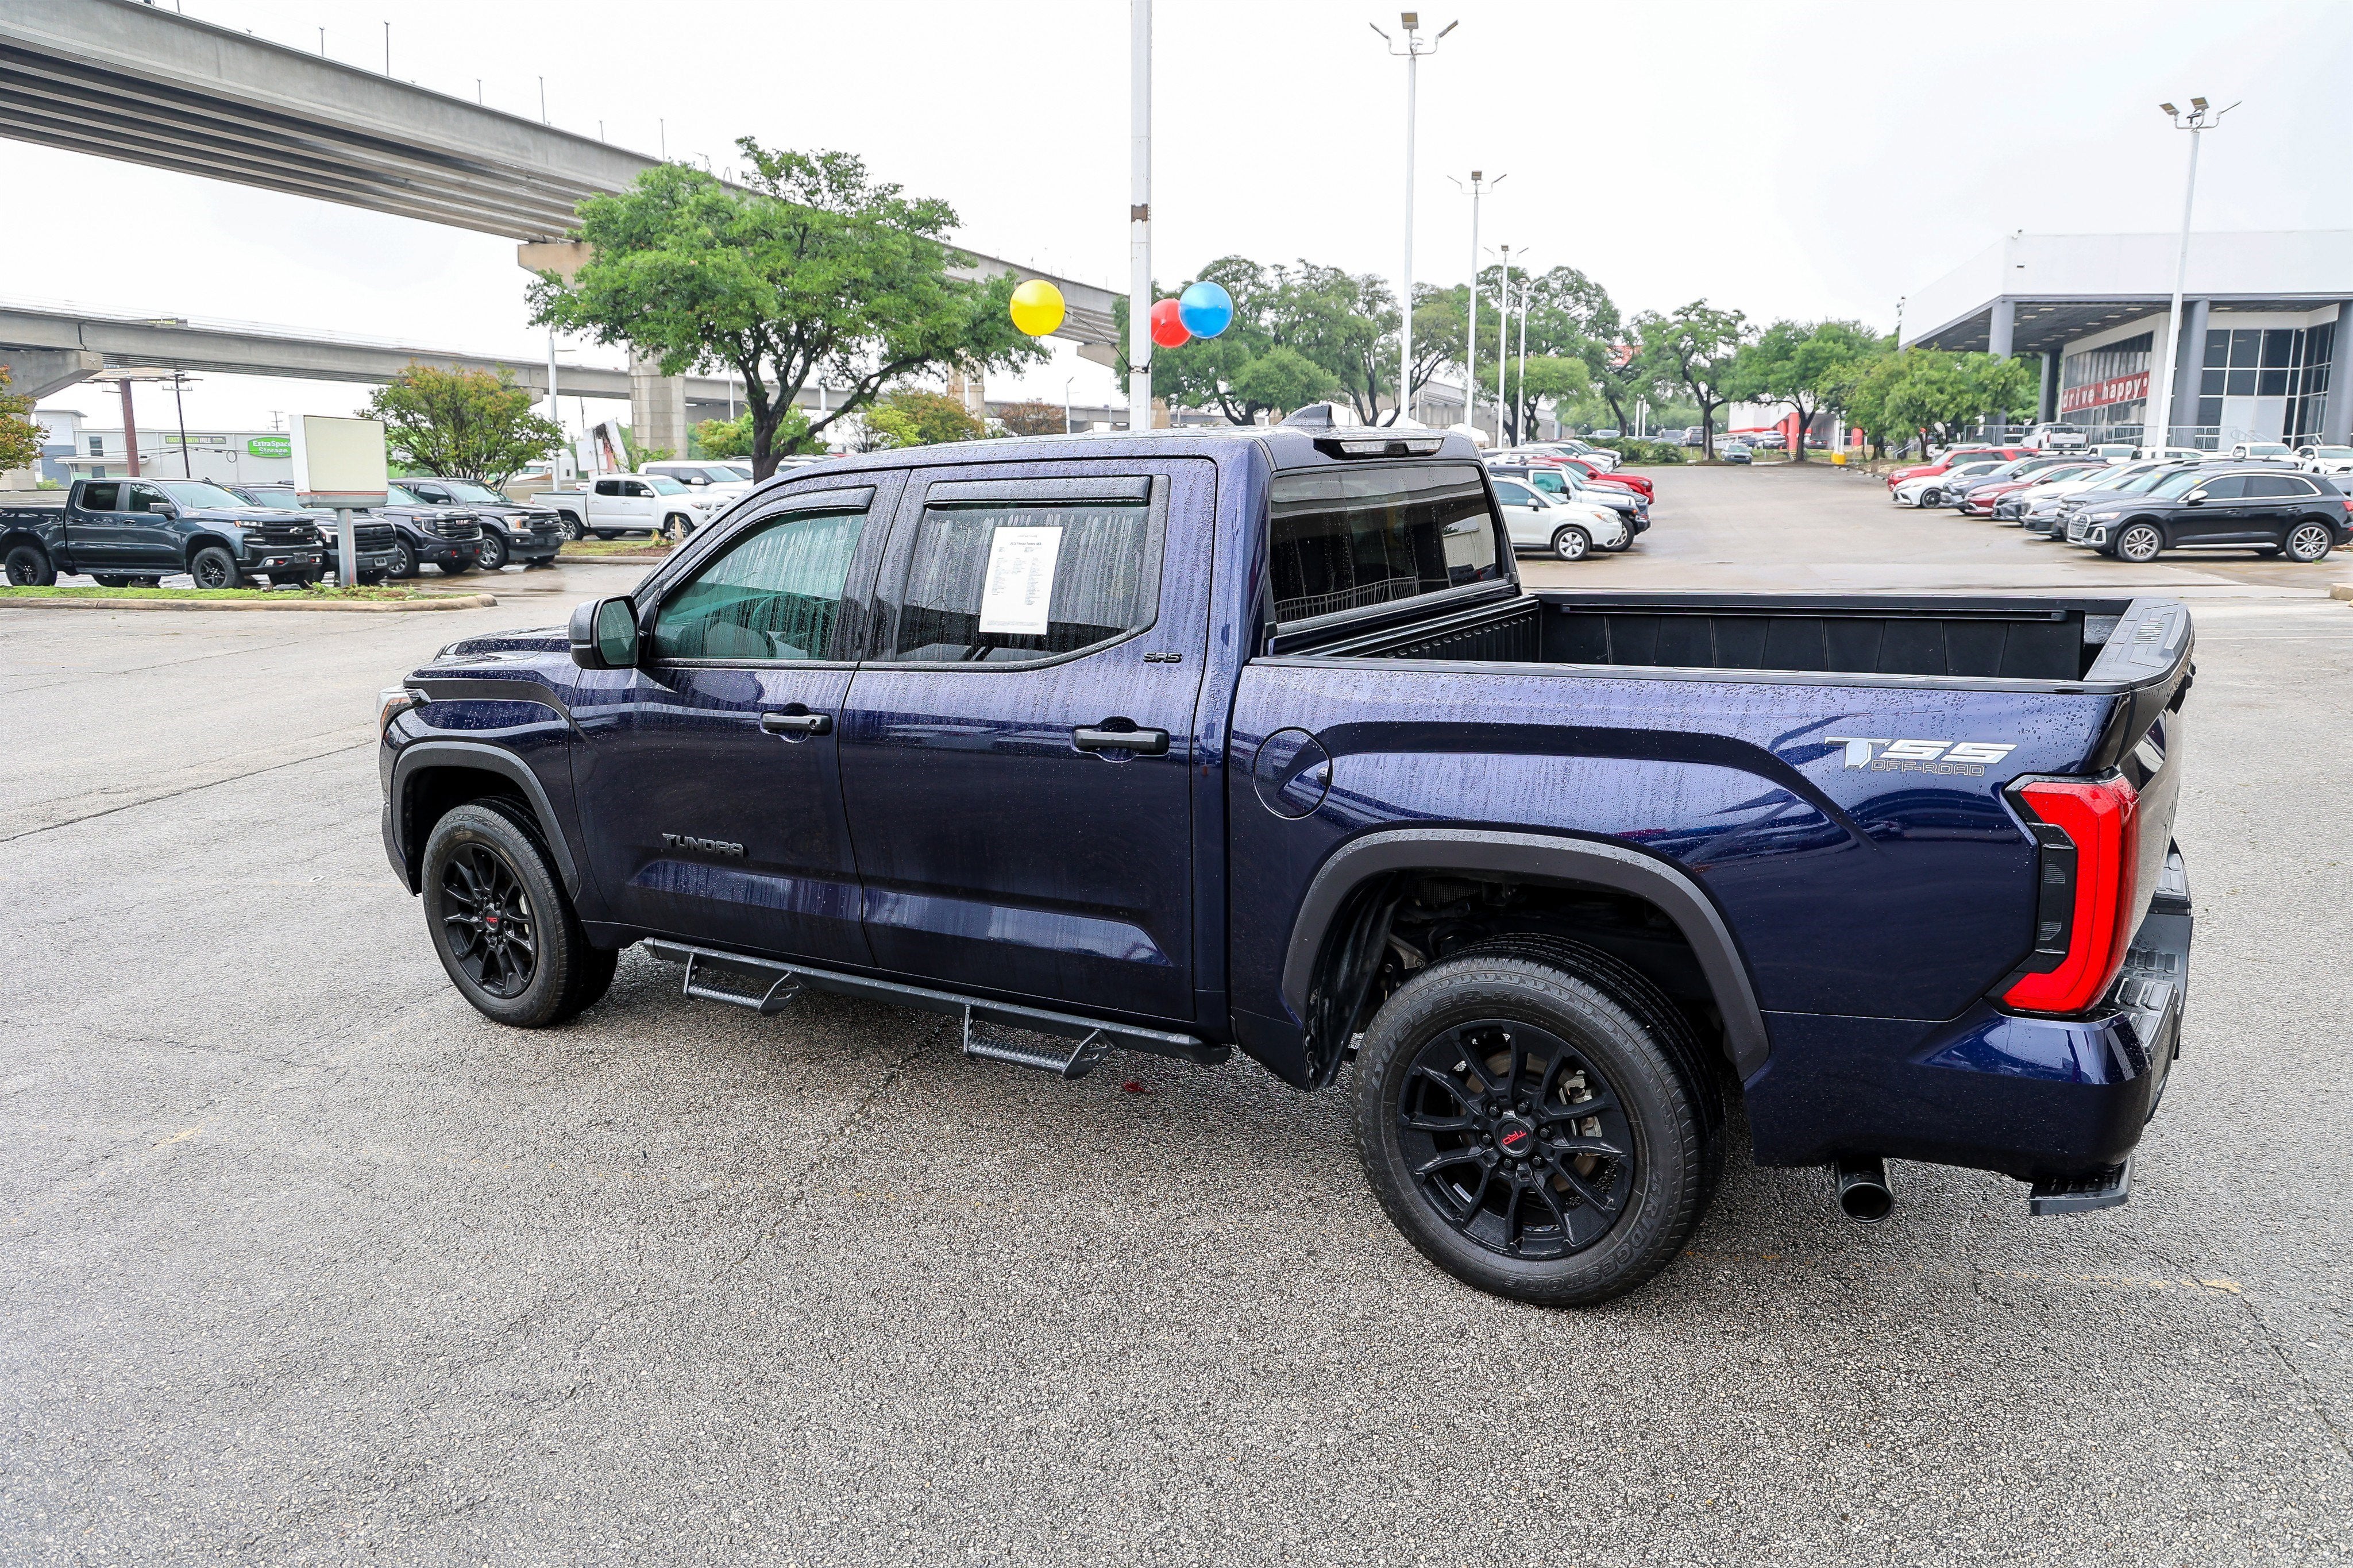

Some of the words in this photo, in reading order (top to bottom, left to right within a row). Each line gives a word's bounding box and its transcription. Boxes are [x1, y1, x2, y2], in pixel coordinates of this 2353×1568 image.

[2062, 388, 2094, 408] drive
[1143, 652, 1182, 663] SR5
[1870, 759, 1985, 777] OFF-ROAD
[662, 833, 744, 858] TUNDRA
[1502, 1130, 1527, 1145] TRD
[1503, 1168, 1665, 1292] BRIDGESTONE
